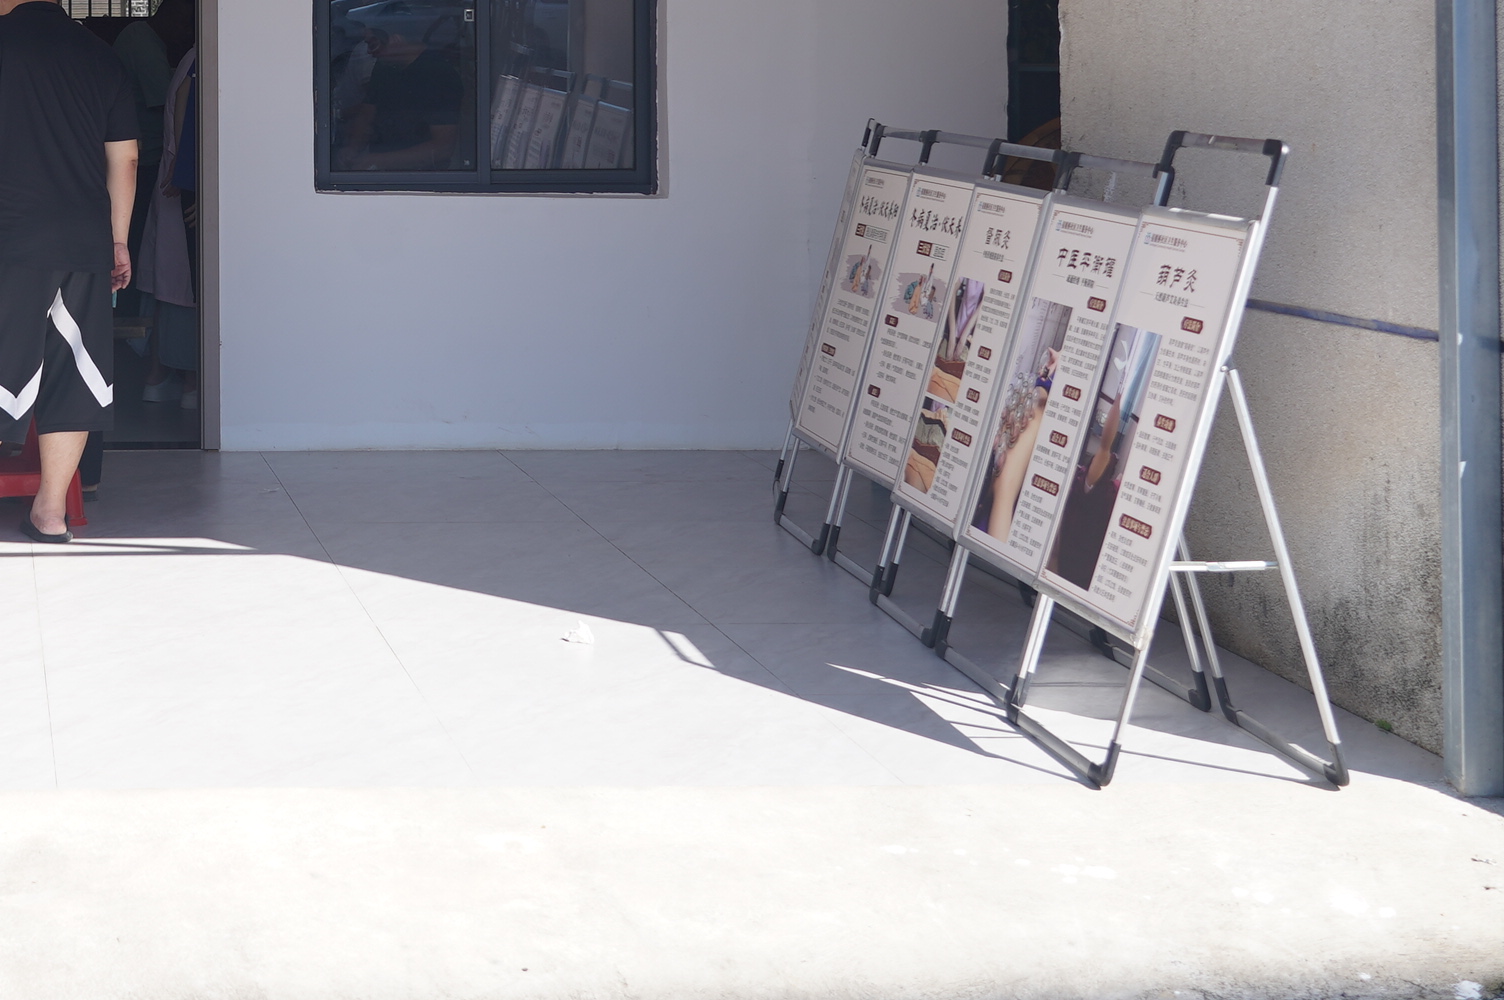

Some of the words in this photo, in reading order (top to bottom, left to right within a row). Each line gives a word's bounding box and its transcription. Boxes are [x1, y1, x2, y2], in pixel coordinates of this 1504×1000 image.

[1057, 248, 1116, 278] 中医平衡罐
[1156, 264, 1197, 293] 葫芦灸
